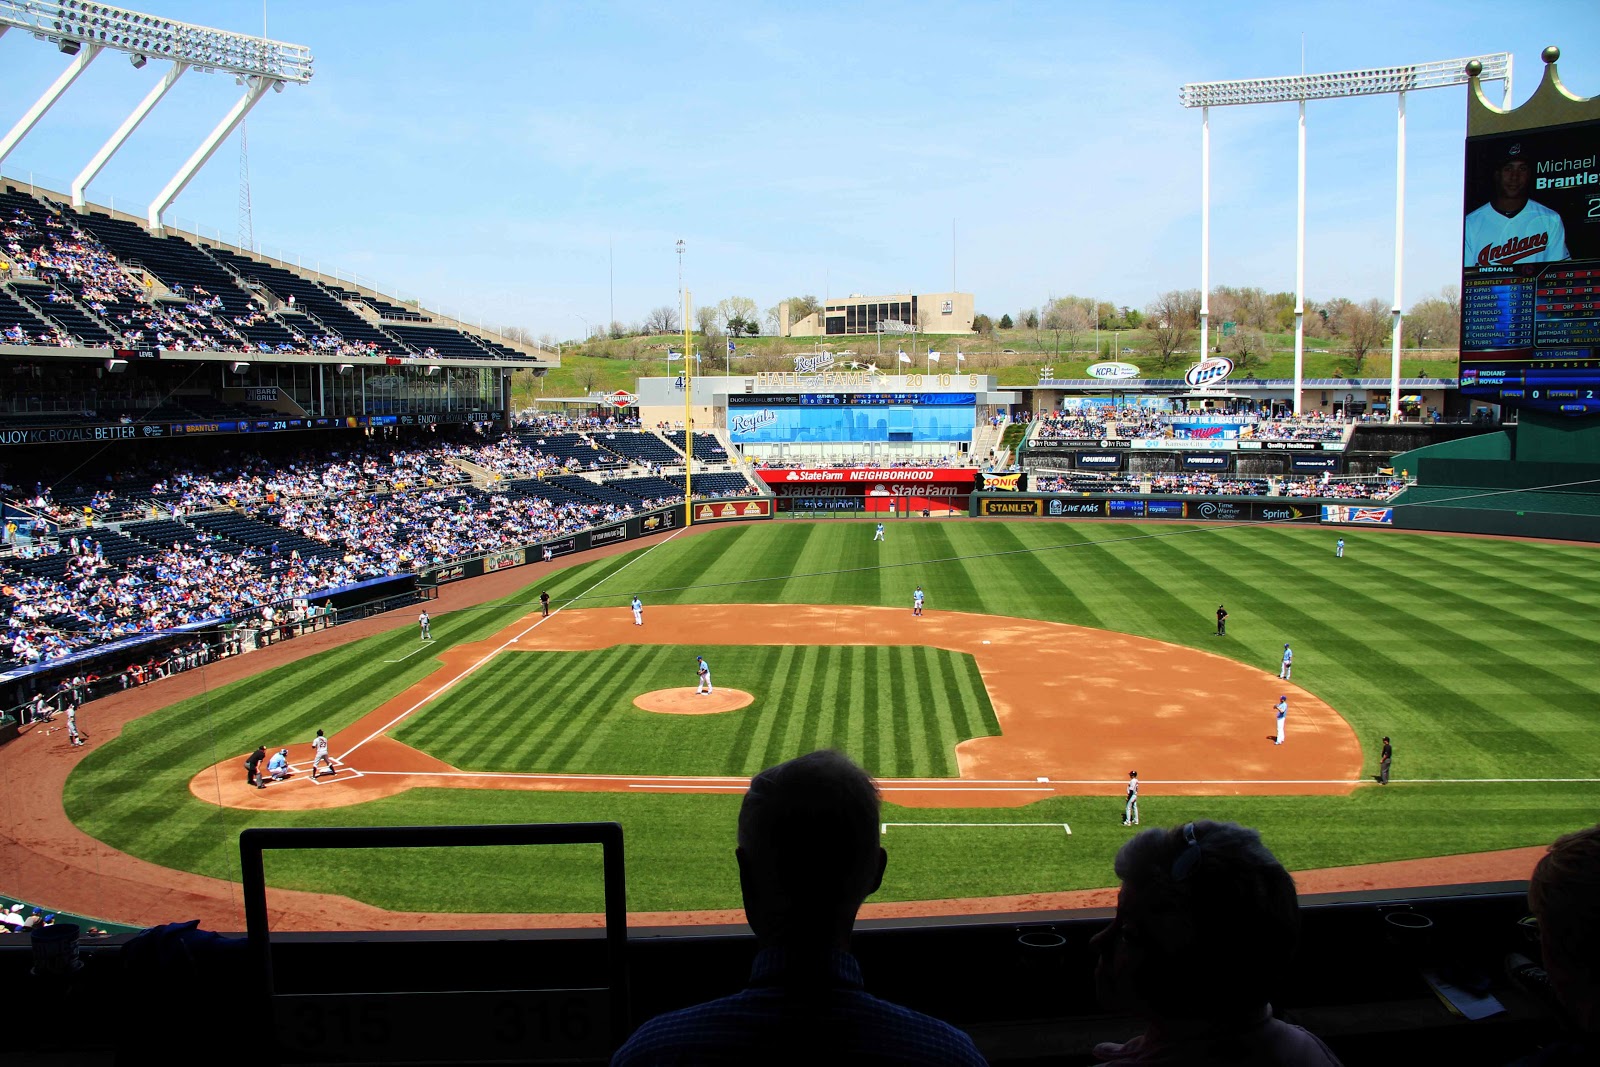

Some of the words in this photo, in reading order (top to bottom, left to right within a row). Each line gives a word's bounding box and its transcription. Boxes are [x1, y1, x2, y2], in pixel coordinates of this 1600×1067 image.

[1537, 155, 1596, 173] Michael
[1536, 172, 1600, 189] Brantle
[1478, 232, 1548, 266] Indians
[794, 351, 834, 373] Royals
[674, 376, 692, 388] 42
[757, 372, 802, 387] HALL
[823, 372, 872, 386] FAME
[906, 374, 923, 387] 20
[938, 374, 951, 387] 10
[969, 374, 978, 387] 5
[1193, 365, 1227, 386] Lite
[1532, 390, 1540, 399] 0
[1586, 390, 1594, 399] 2
[418, 415, 438, 424] ENJOY
[468, 413, 488, 422] BETTER
[732, 407, 777, 433] Royals
[1234, 416, 1245, 424] CITY
[186, 423, 219, 432] BRANTLEY
[272, 420, 287, 430] .274
[31, 431, 47, 442] KC
[50, 428, 92, 441] ROYALS
[95, 426, 136, 438] BETTER
[1190, 441, 1204, 449] City
[1267, 442, 1287, 450] Quality
[849, 471, 935, 481] NEIGHBORHOOD
[985, 477, 1019, 487] SONIC
[989, 503, 1034, 513] STANLEY
[1062, 504, 1079, 513] LIVE
[1079, 502, 1099, 513] MÁS
[1263, 509, 1290, 519] Sprint
[295, 1002, 391, 1047] 315
[494, 998, 590, 1043] 316
